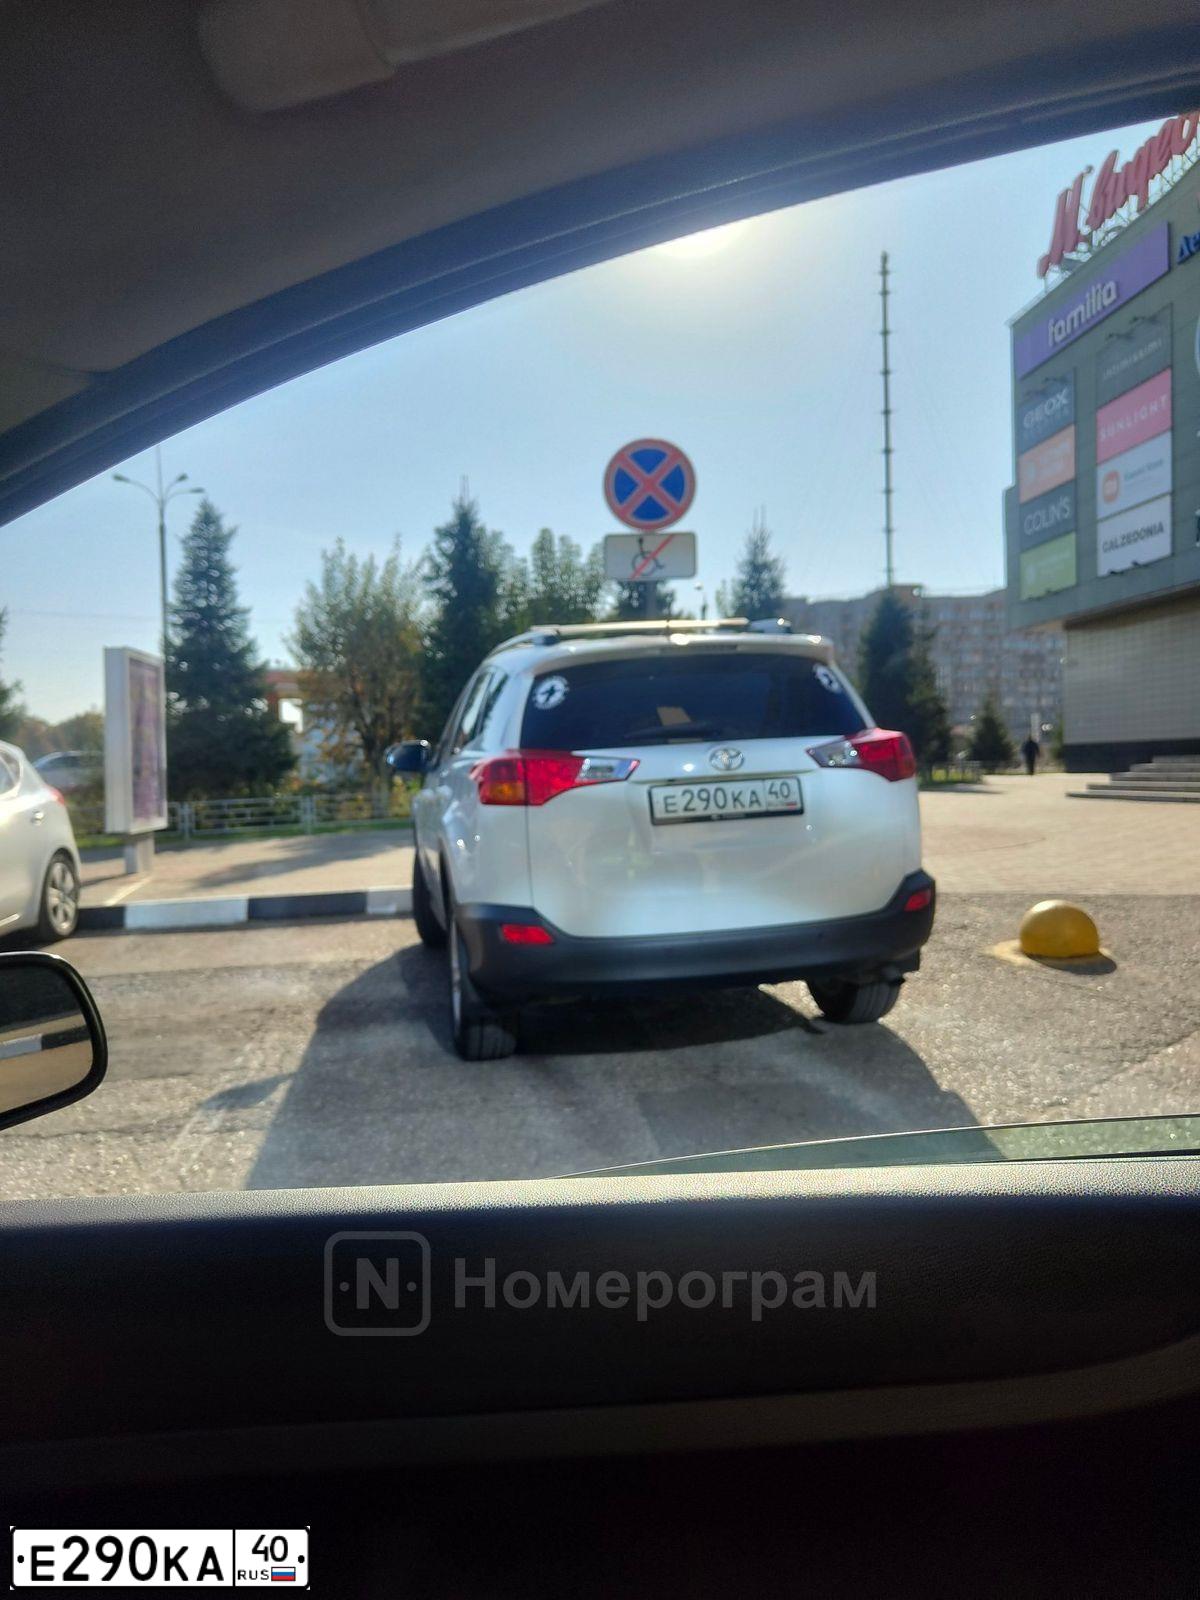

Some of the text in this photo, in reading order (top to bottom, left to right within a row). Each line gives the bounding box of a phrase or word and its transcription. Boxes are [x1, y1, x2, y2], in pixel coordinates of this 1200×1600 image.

[1048, 281, 1117, 347] familia
[1101, 394, 1168, 441] SUNLIGHT
[1102, 520, 1165, 553] CALZEDONIA
[768, 781, 791, 799] 40
